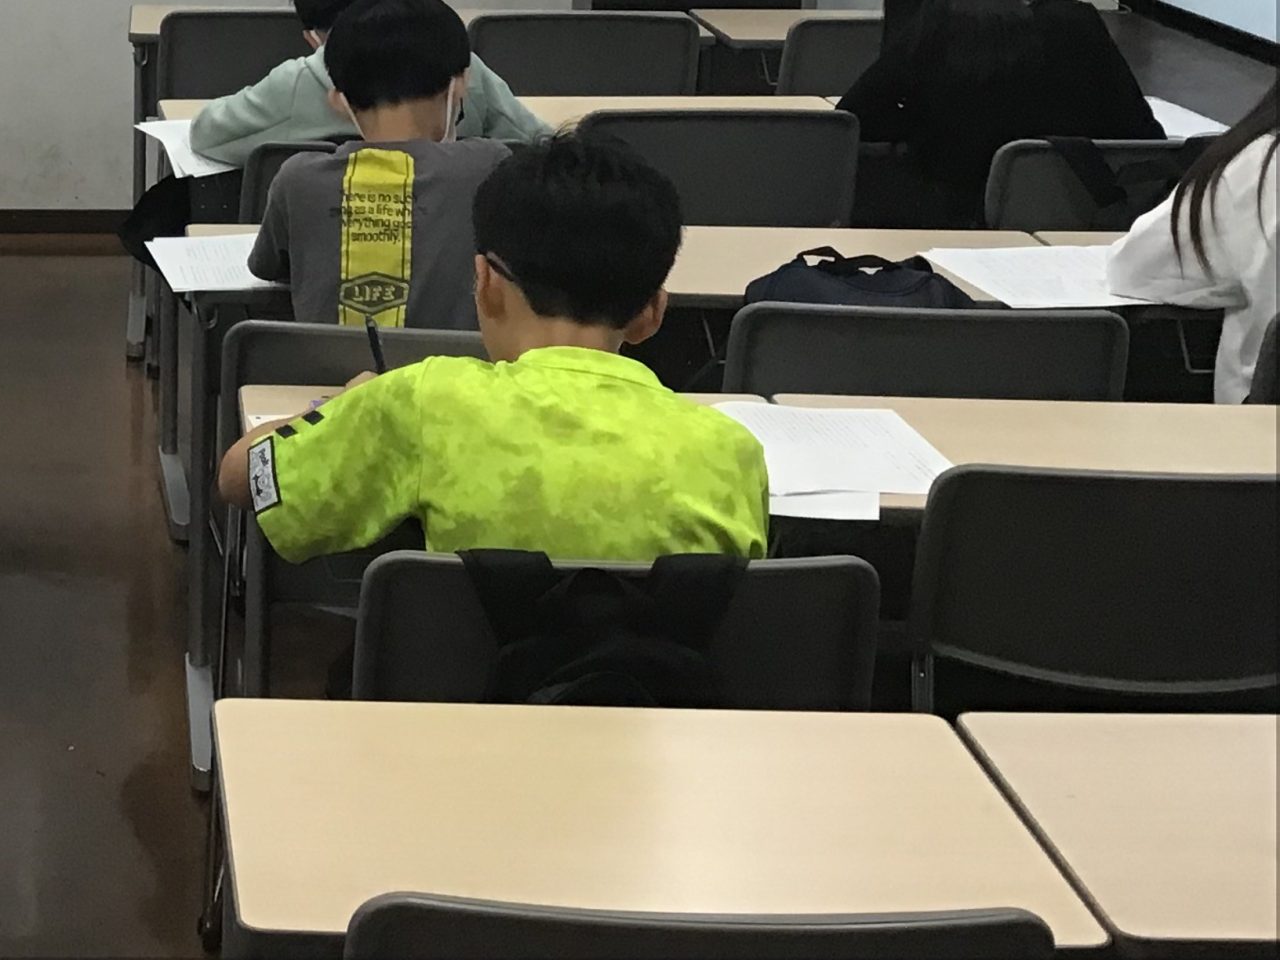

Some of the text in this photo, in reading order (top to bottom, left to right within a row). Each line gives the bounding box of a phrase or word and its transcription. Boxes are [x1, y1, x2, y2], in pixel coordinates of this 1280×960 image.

[378, 193, 391, 203] no
[376, 204, 393, 216] life
[351, 285, 396, 301] LIFE
